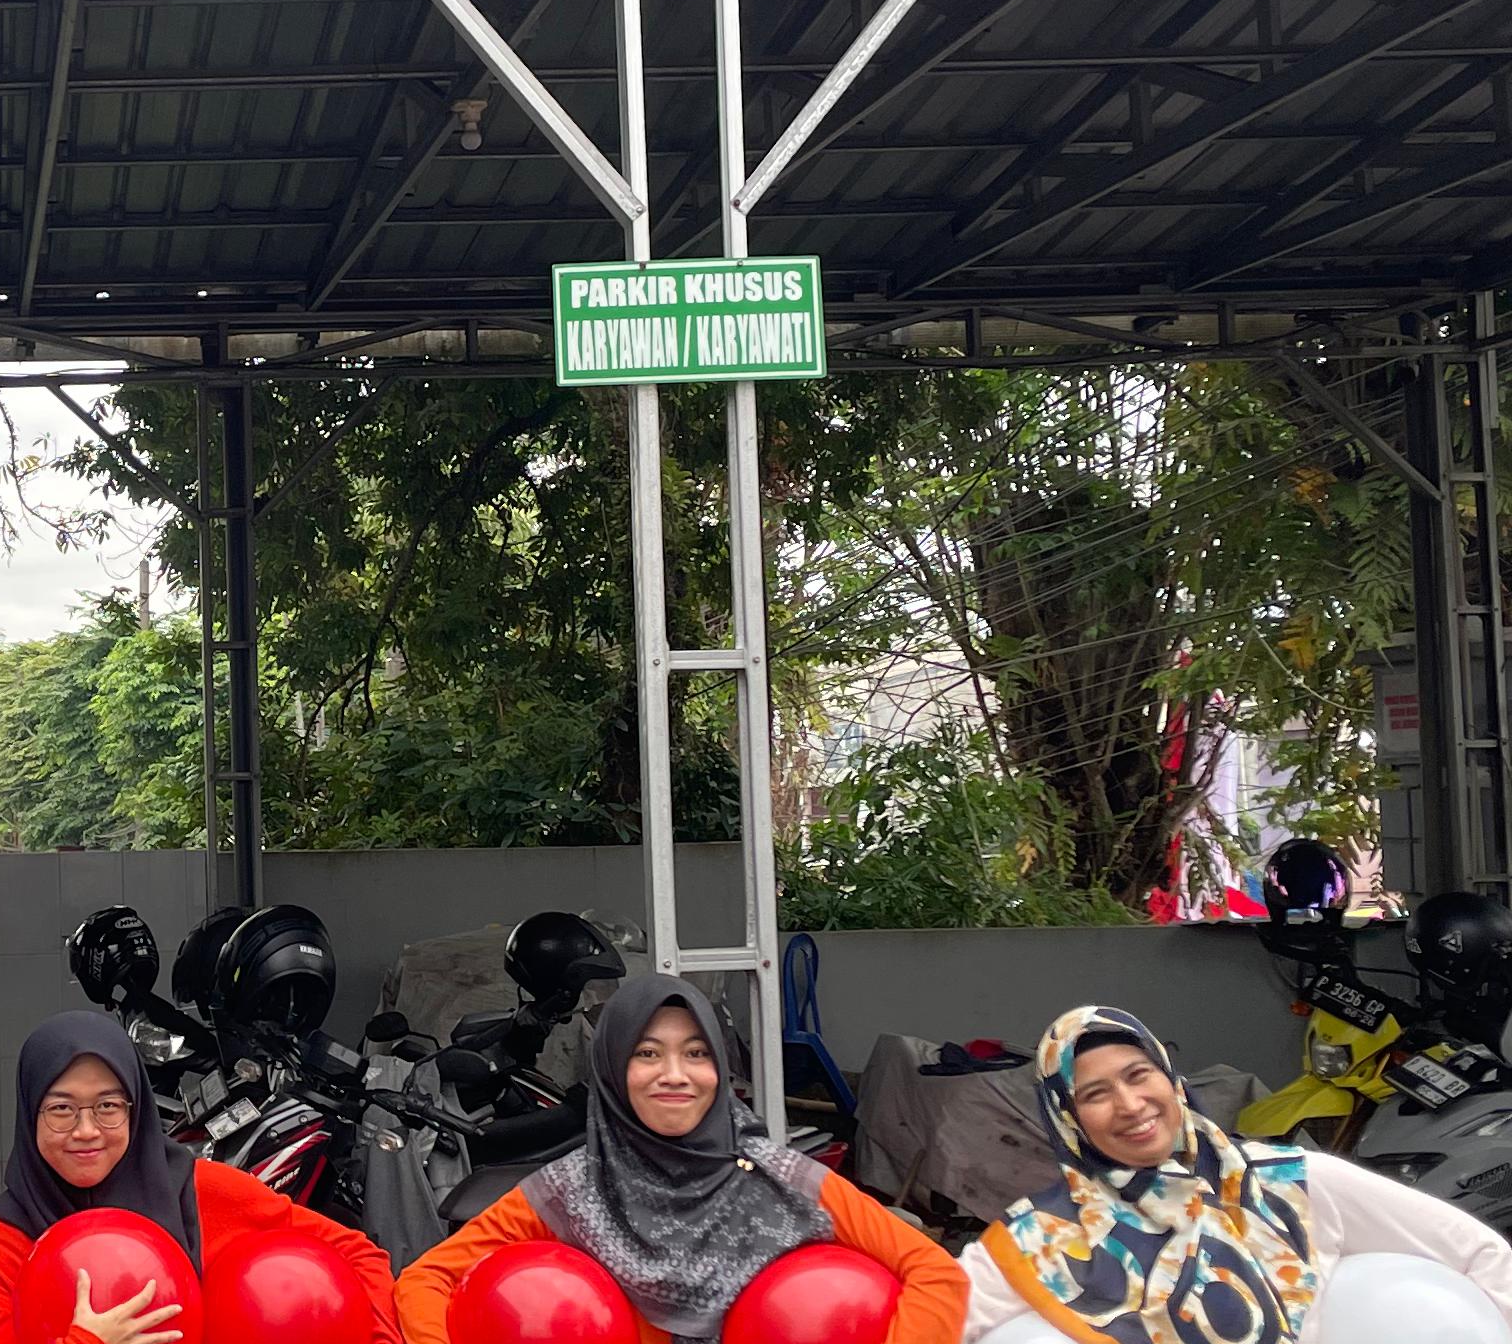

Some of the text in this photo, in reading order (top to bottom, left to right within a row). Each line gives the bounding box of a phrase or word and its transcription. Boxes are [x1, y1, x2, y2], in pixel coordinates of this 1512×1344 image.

[571, 271, 803, 308] PARKIR KHUSUS
[567, 317, 678, 371] KARYAWAN
[696, 312, 813, 366] KARYAWATI
